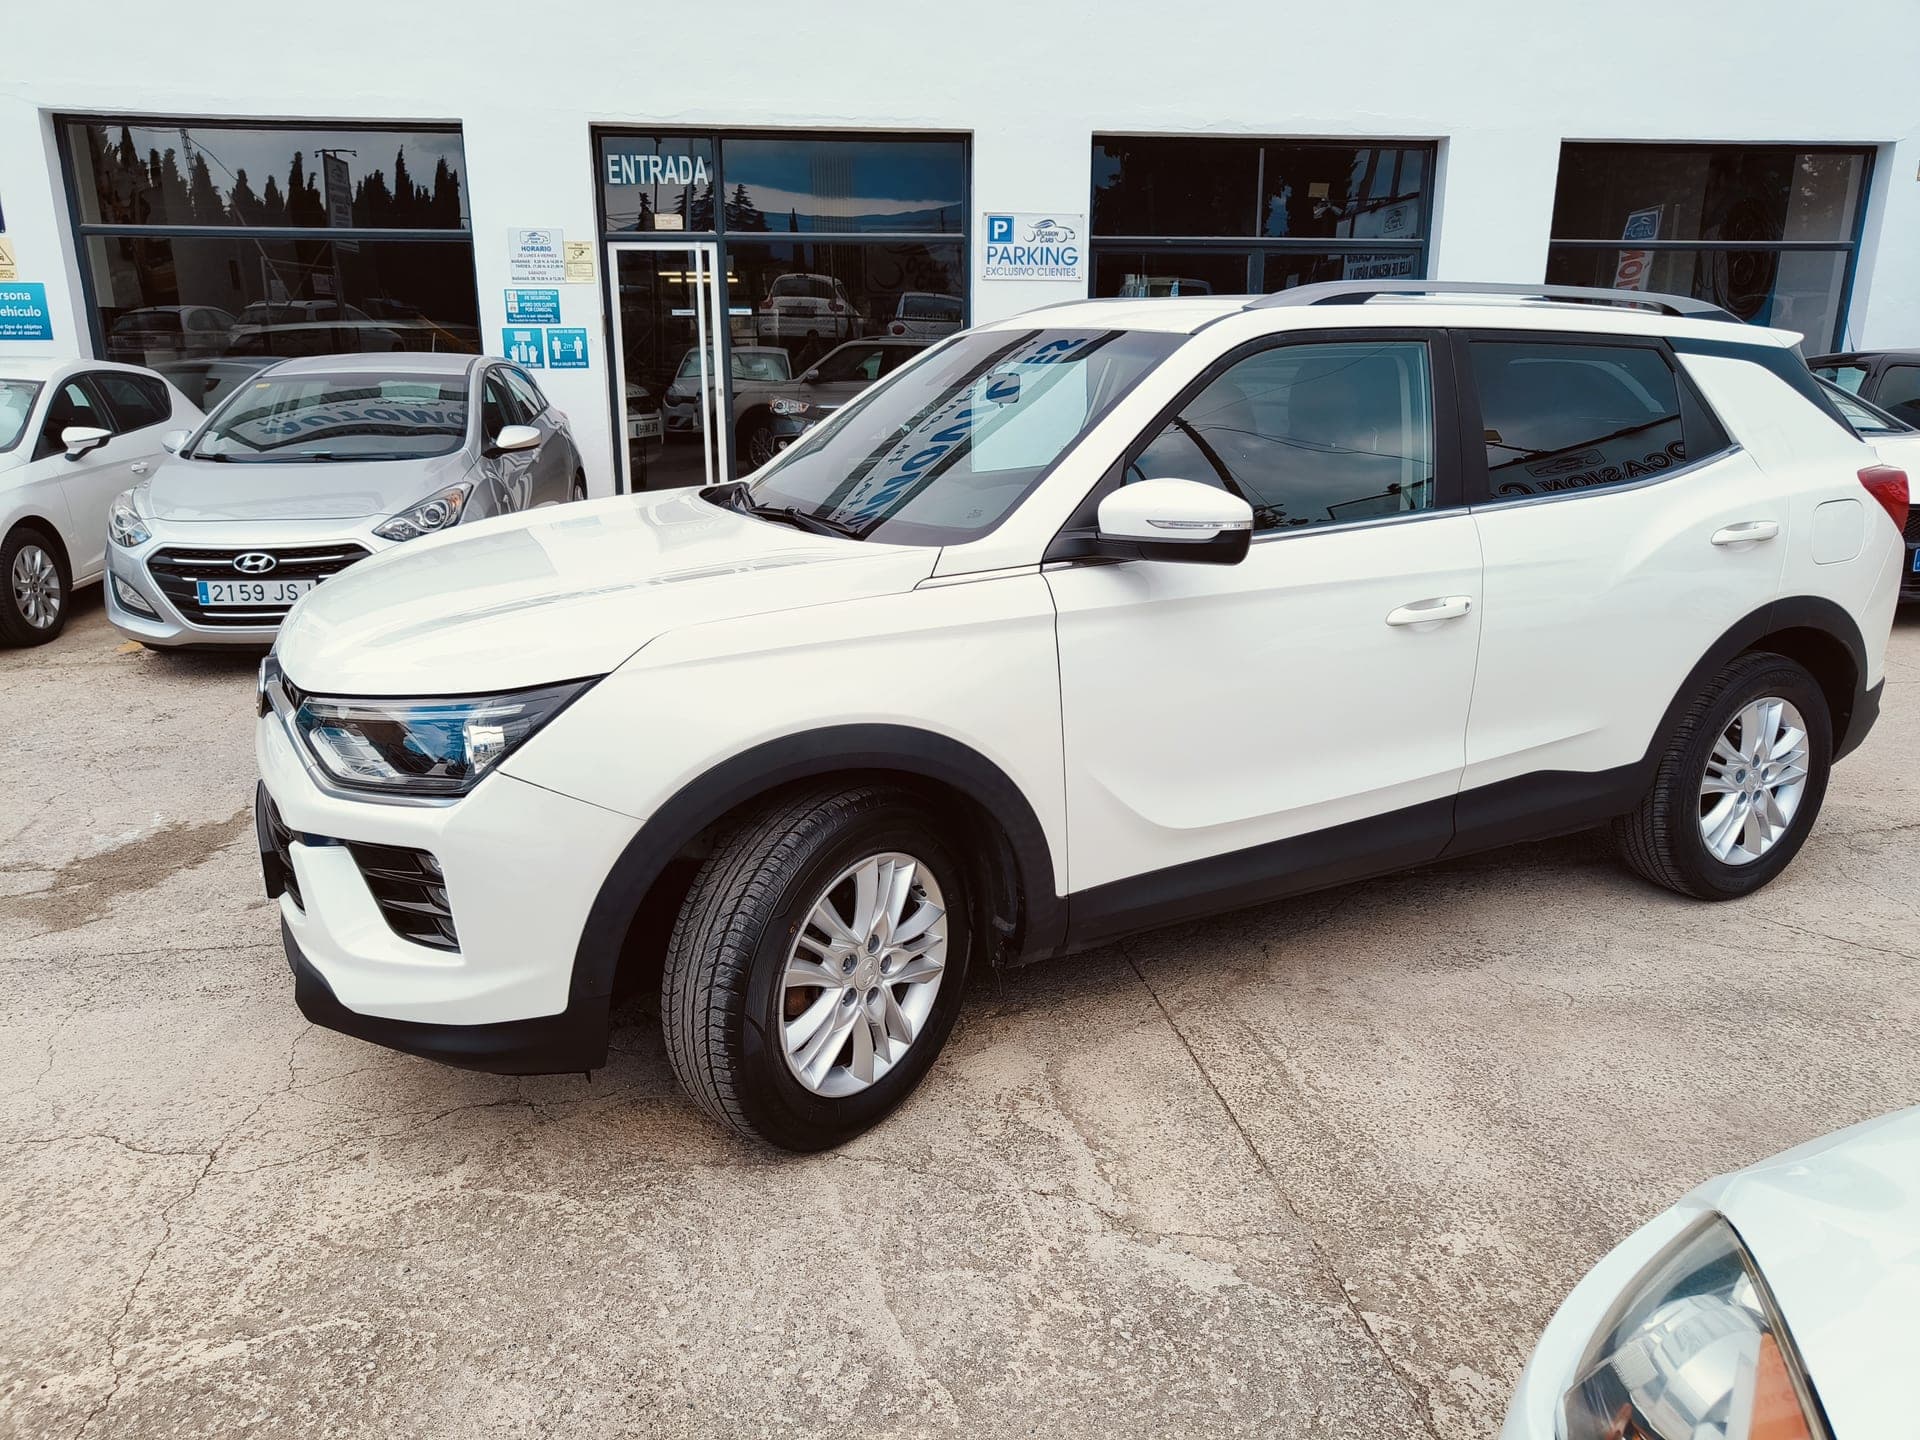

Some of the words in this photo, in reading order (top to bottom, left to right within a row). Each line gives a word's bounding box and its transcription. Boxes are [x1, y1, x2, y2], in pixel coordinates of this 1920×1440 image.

[607, 154, 709, 185] ENTRADA
[993, 220, 1008, 240] P
[987, 245, 1078, 266] PARKING
[985, 266, 1035, 276] EXCLUSIVO
[1037, 267, 1077, 277] CLIENTES
[0, 291, 32, 301] rsona
[0, 304, 42, 317] ehículo
[212, 584, 265, 602] 2159
